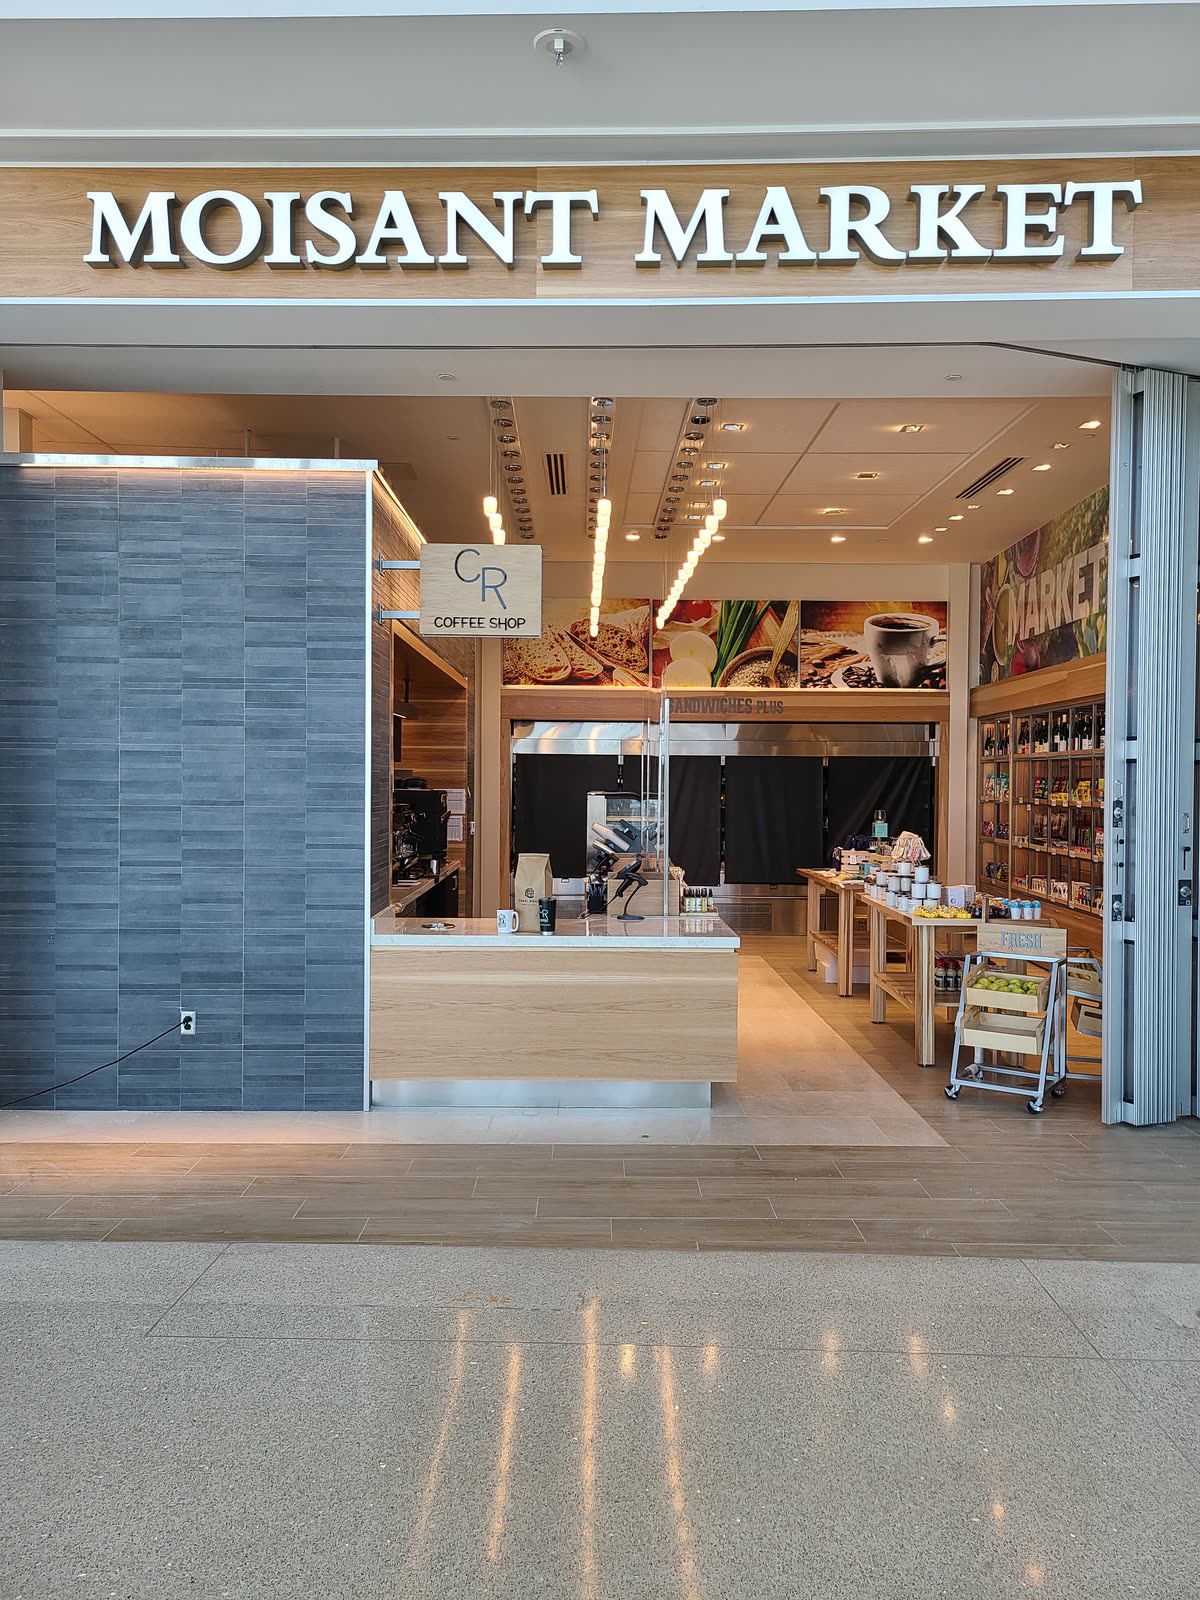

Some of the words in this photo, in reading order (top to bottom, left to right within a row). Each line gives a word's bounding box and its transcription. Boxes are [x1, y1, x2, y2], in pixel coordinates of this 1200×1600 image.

[83, 189, 599, 268] MOISANT
[635, 179, 1143, 267] MARKET
[1006, 541, 1106, 646] MARKET
[433, 616, 486, 629] COFFEE
[489, 617, 526, 631] SHOP
[756, 700, 784, 714] PLUS
[1000, 931, 1042, 949] FRESH
